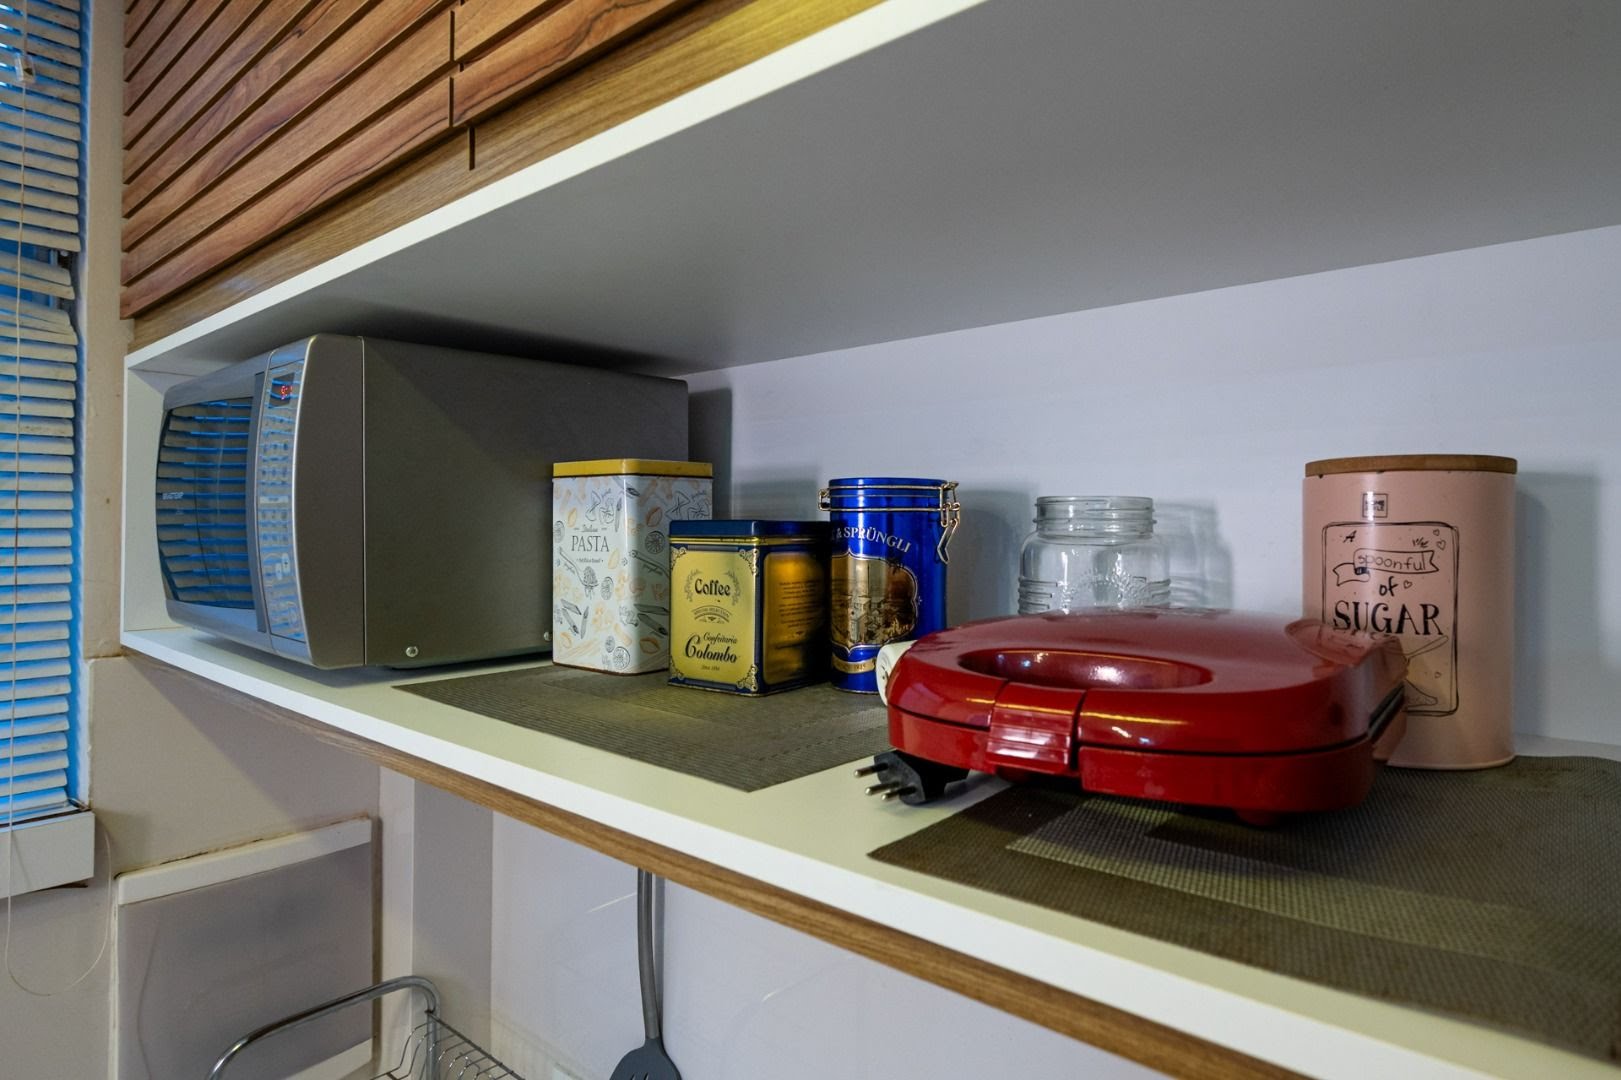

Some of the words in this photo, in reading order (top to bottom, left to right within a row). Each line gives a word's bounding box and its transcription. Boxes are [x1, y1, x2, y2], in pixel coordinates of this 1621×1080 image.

[571, 535, 610, 552] PASTA
[843, 526, 911, 553] SPRÜNGLI
[1358, 552, 1426, 571] spoonful
[694, 578, 731, 596] Coffee
[1379, 575, 1399, 597] of
[1332, 600, 1443, 635] SUGAR
[685, 634, 737, 663] Colombo
[703, 632, 737, 645] Confeitaria
